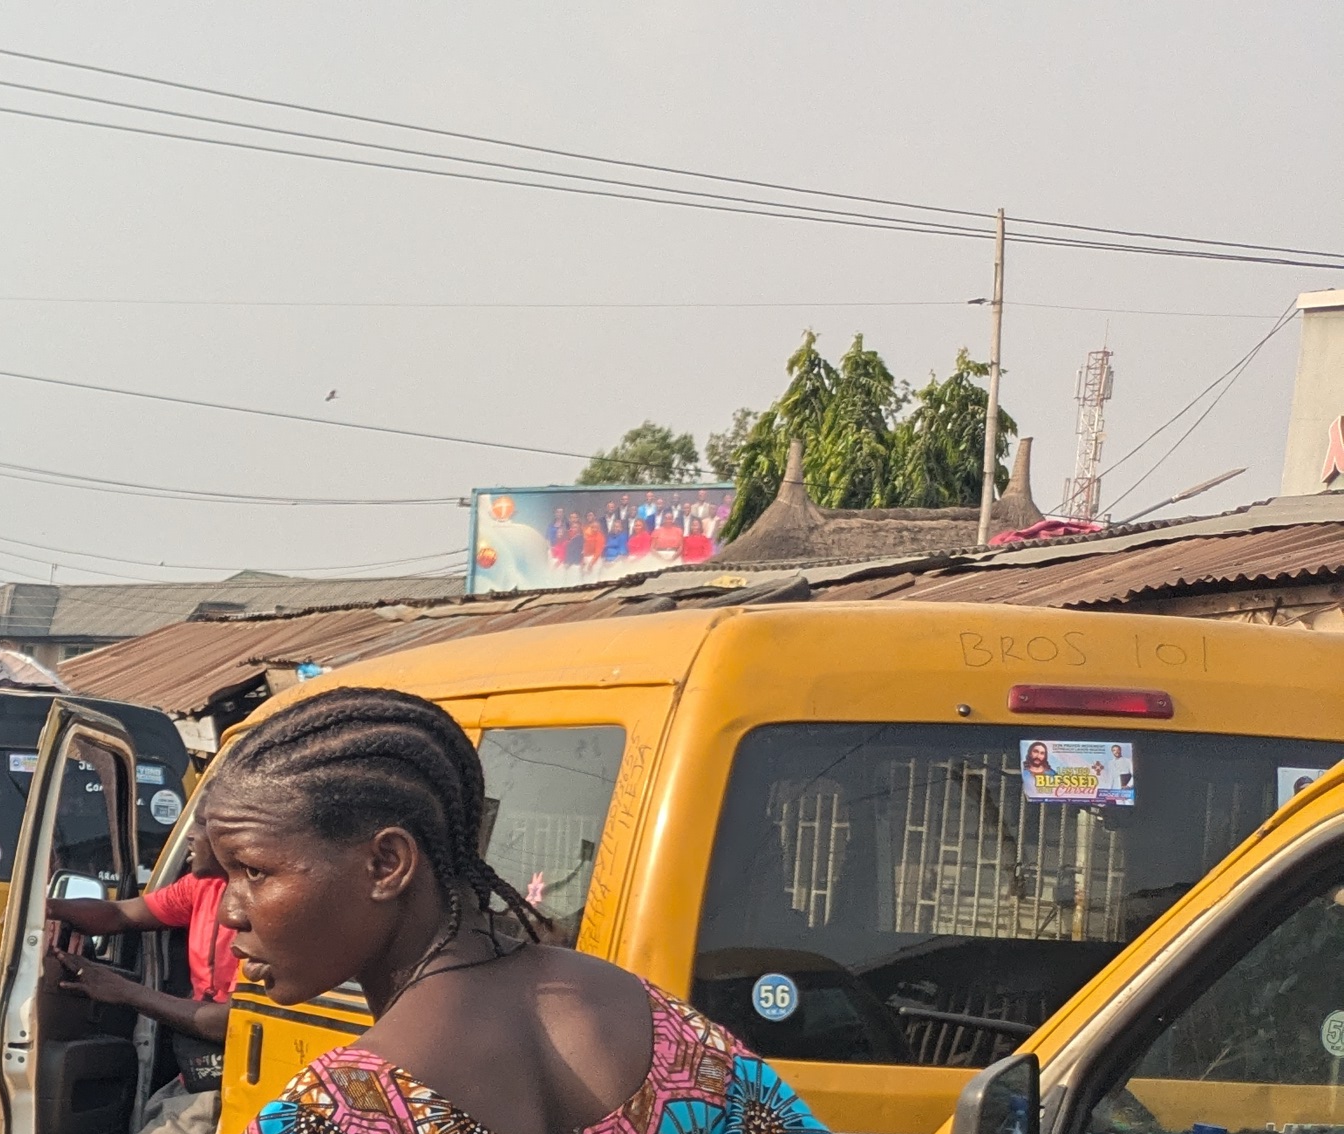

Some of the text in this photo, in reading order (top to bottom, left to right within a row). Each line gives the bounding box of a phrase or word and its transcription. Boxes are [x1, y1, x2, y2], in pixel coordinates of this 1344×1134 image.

[959, 631, 1087, 668] BROS
[1035, 774, 1099, 787] BLESSED
[759, 985, 790, 1009] 56
